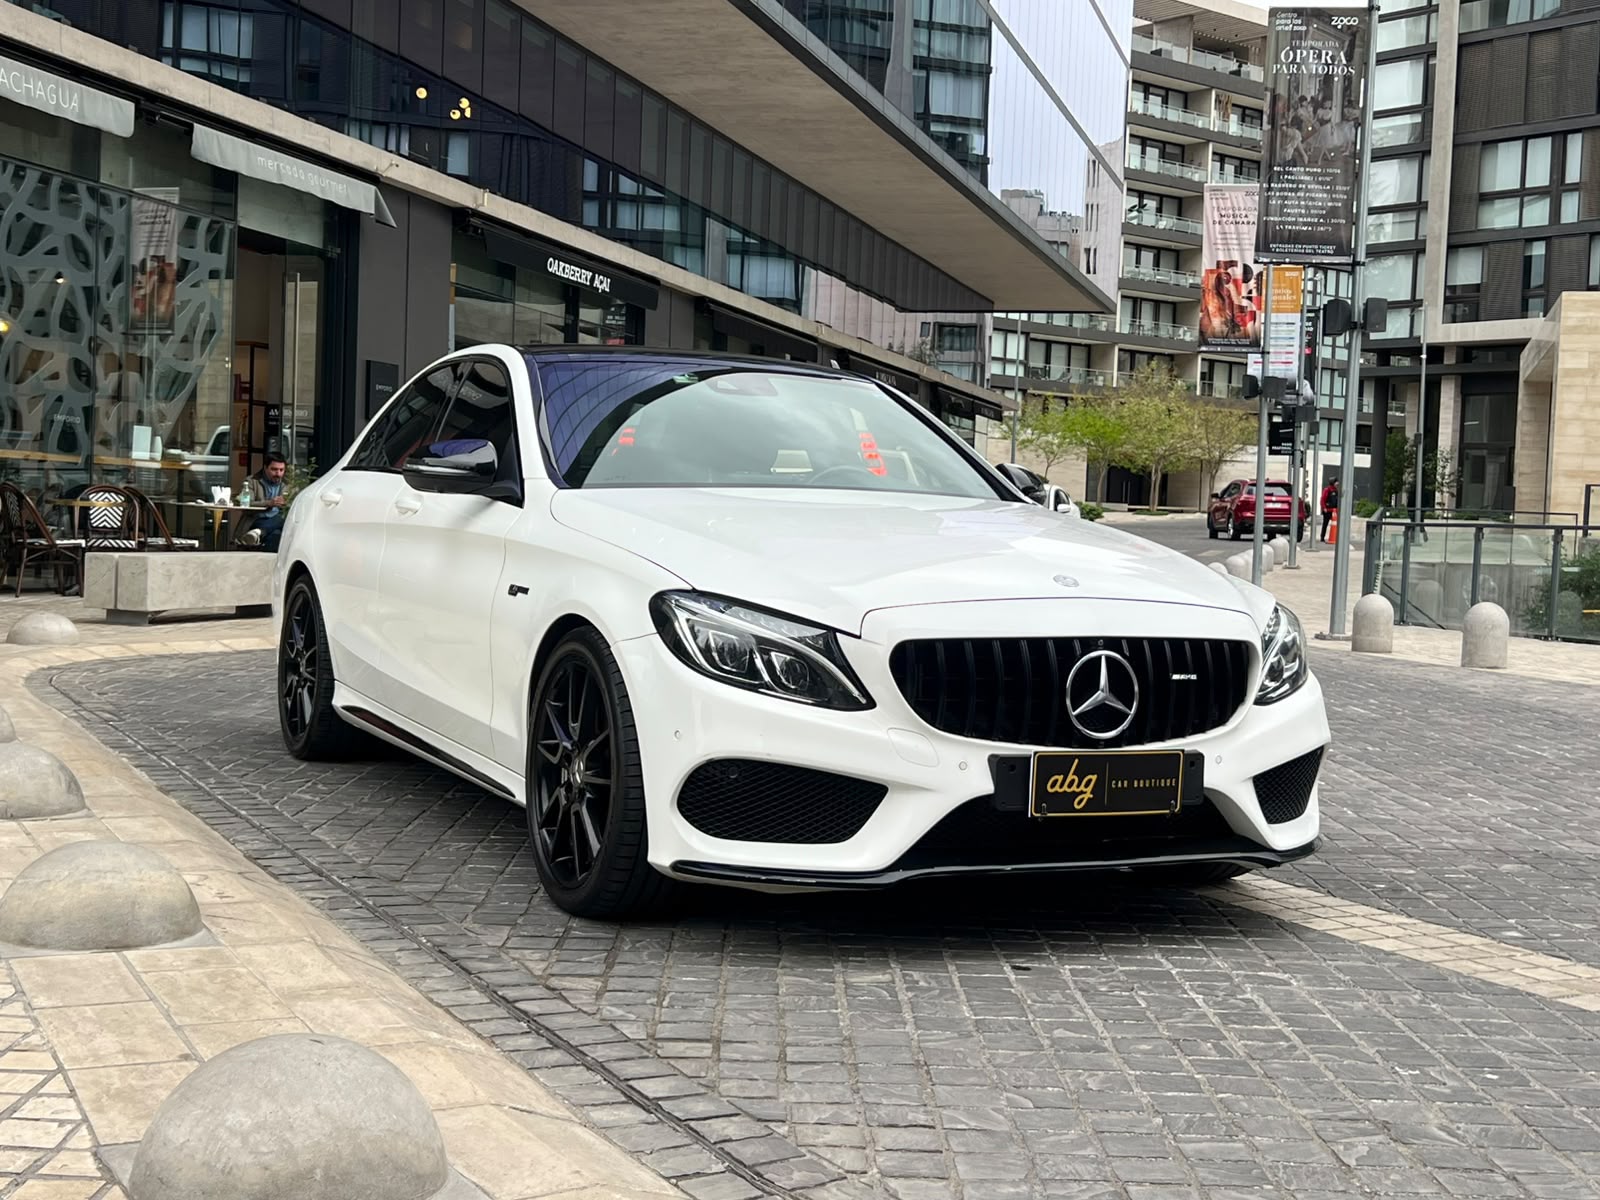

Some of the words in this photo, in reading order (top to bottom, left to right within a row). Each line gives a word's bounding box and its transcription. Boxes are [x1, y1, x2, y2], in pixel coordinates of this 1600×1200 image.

[1280, 46, 1347, 64] ÓPERA
[1272, 64, 1307, 74] PARA
[1312, 65, 1356, 75] TODOS
[257, 157, 305, 180] mercado
[547, 257, 592, 286] OAKBERRY
[593, 274, 611, 293] AÇAI
[1046, 758, 1098, 809] abg
[1111, 780, 1128, 788] CAR
[1134, 778, 1176, 788] BOUTIQUE
